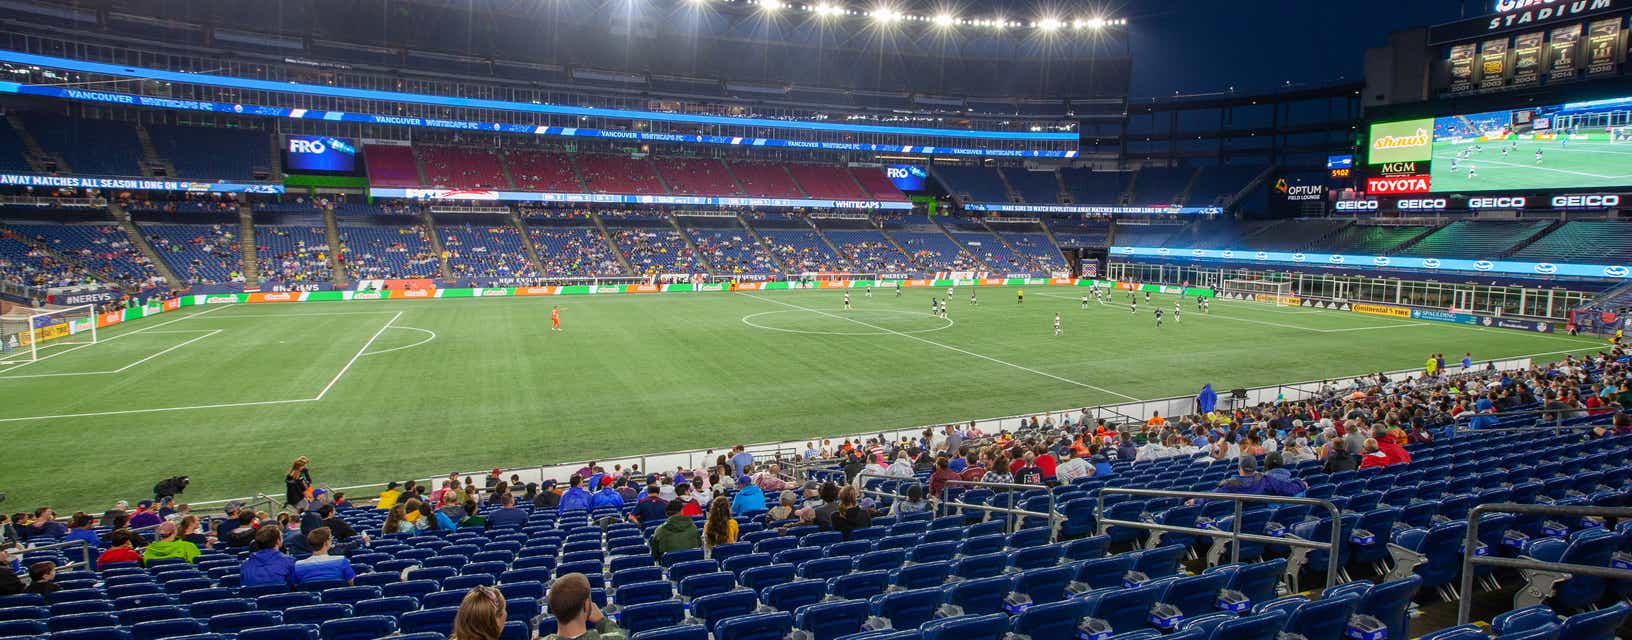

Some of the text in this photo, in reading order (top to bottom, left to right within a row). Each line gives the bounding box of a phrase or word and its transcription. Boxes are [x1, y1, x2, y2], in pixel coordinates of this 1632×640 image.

[1489, 0, 1611, 29] STADIUM
[68, 90, 133, 104] VANCOUVER
[140, 97, 198, 110] WHITECAPS
[376, 116, 420, 125] VANCOUVER
[426, 119, 467, 129] WHITECAPS
[601, 130, 638, 139] VANCOUVER
[1382, 162, 1416, 173] MGM
[1, 175, 177, 190] AWAY MATCHES ALL SEASON LONG ON
[1370, 179, 1427, 192] TOYOTA
[1288, 185, 1321, 195] OPTUM
[836, 200, 880, 209] WHITECAPS
[1335, 200, 1379, 210] GEICO
[1397, 199, 1446, 209] GEICO
[1469, 197, 1526, 208] GEICO
[1552, 195, 1620, 207] GEICO
[66, 294, 111, 304] #NEREVS
[1353, 303, 1388, 314] Continental
